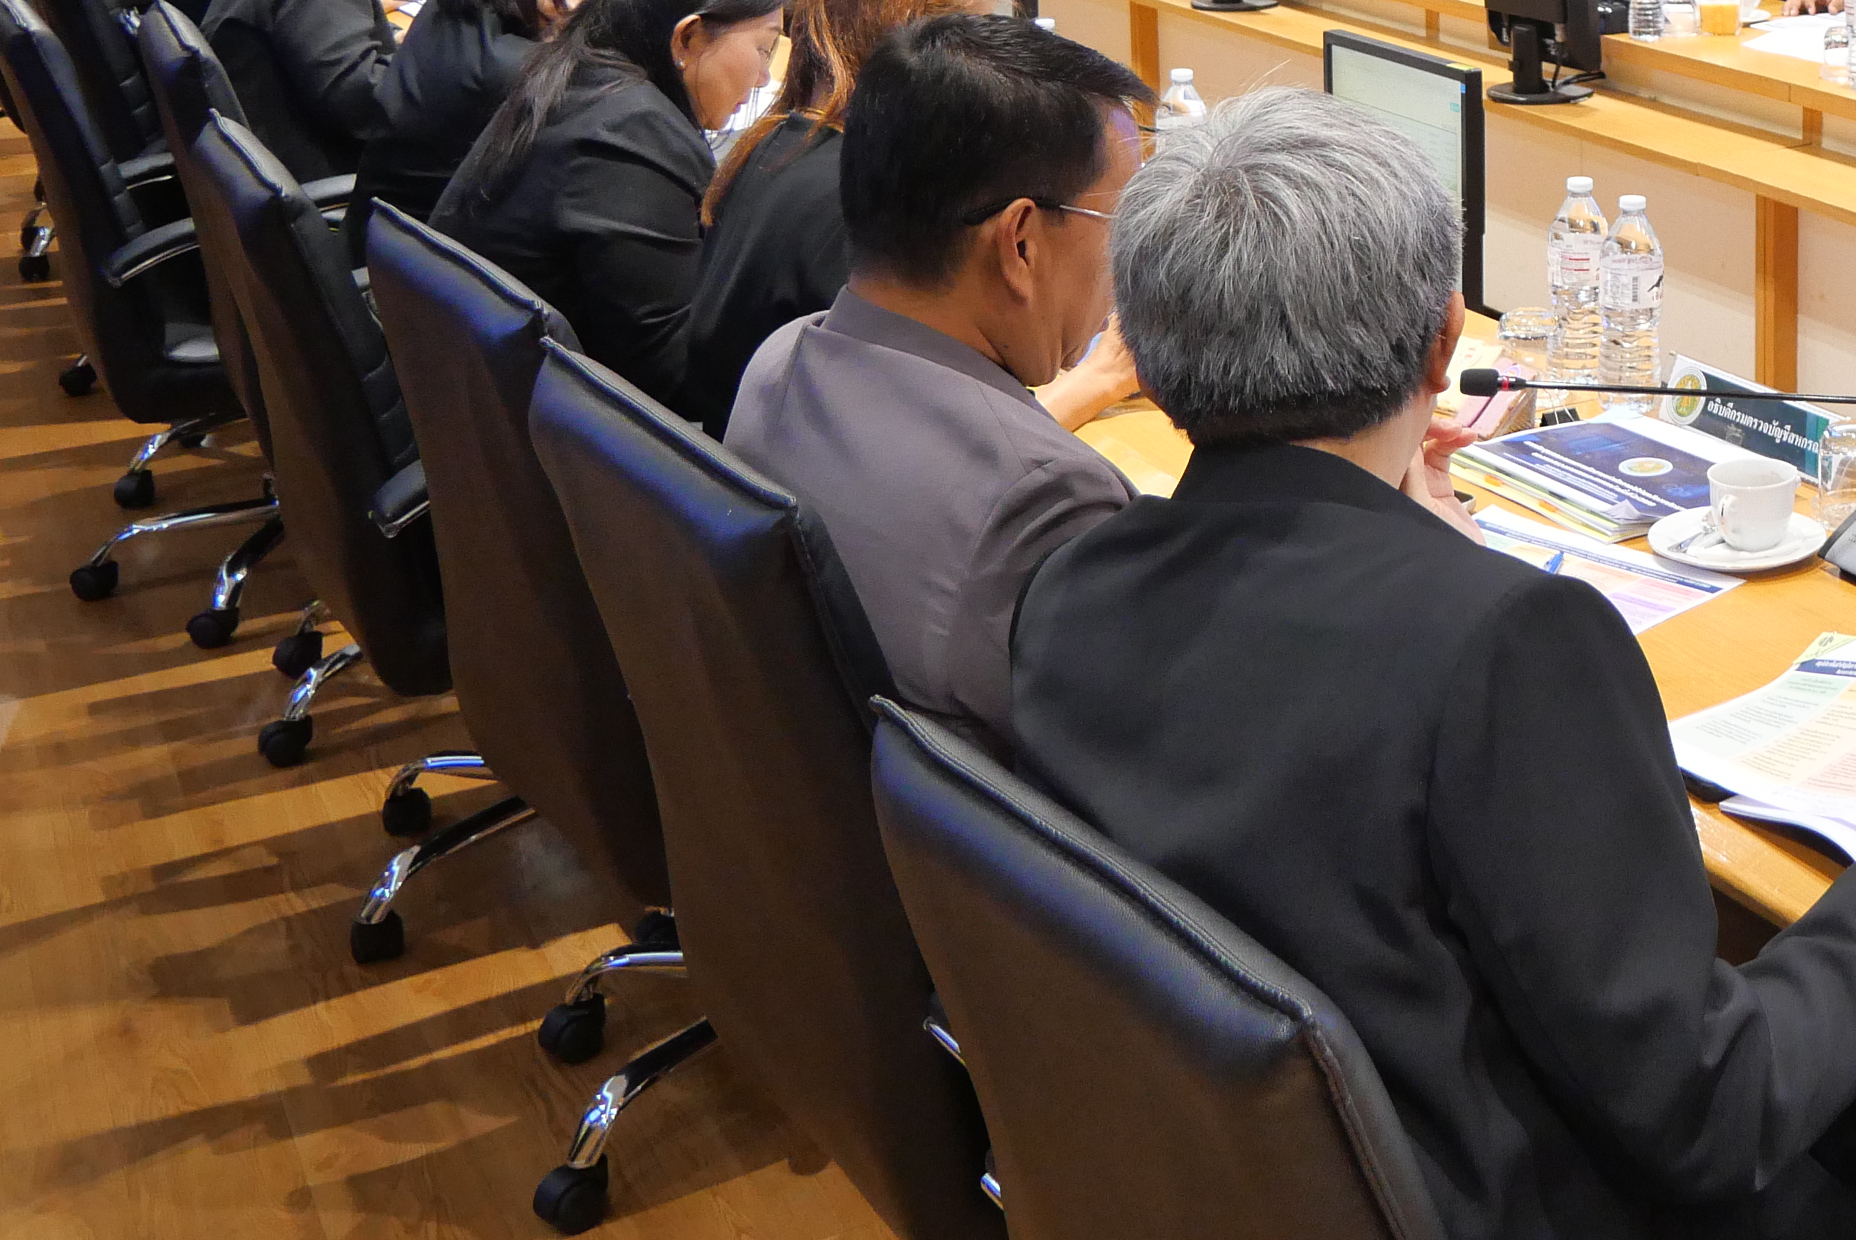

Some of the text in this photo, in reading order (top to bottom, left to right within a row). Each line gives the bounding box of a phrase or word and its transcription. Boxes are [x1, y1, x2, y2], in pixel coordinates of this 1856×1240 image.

[1707, 397, 1819, 454] อธิบดีกรมตรวจบัญชีสหกรณ
